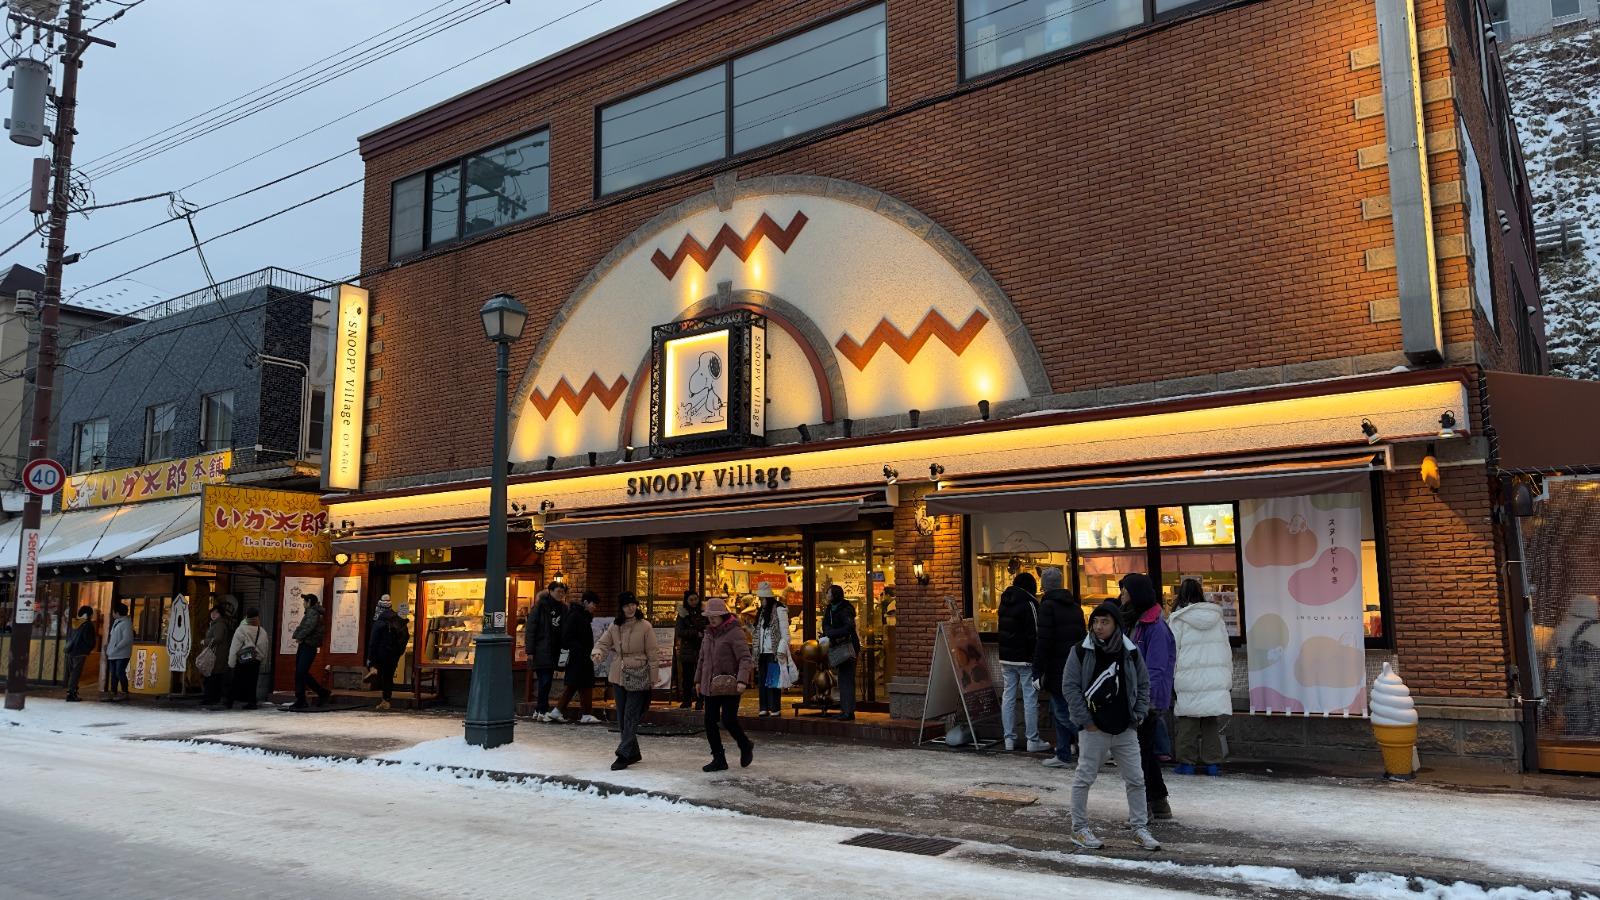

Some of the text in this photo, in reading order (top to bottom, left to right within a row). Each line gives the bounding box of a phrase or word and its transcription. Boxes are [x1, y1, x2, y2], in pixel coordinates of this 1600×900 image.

[347, 321, 357, 373] SNOOPY
[340, 379, 355, 426] Village
[32, 469, 56, 485] 40
[627, 464, 791, 496] SNOOPY Village
[215, 506, 327, 536] いか太郎
[244, 536, 260, 546] Ika
[261, 537, 280, 547] Taro
